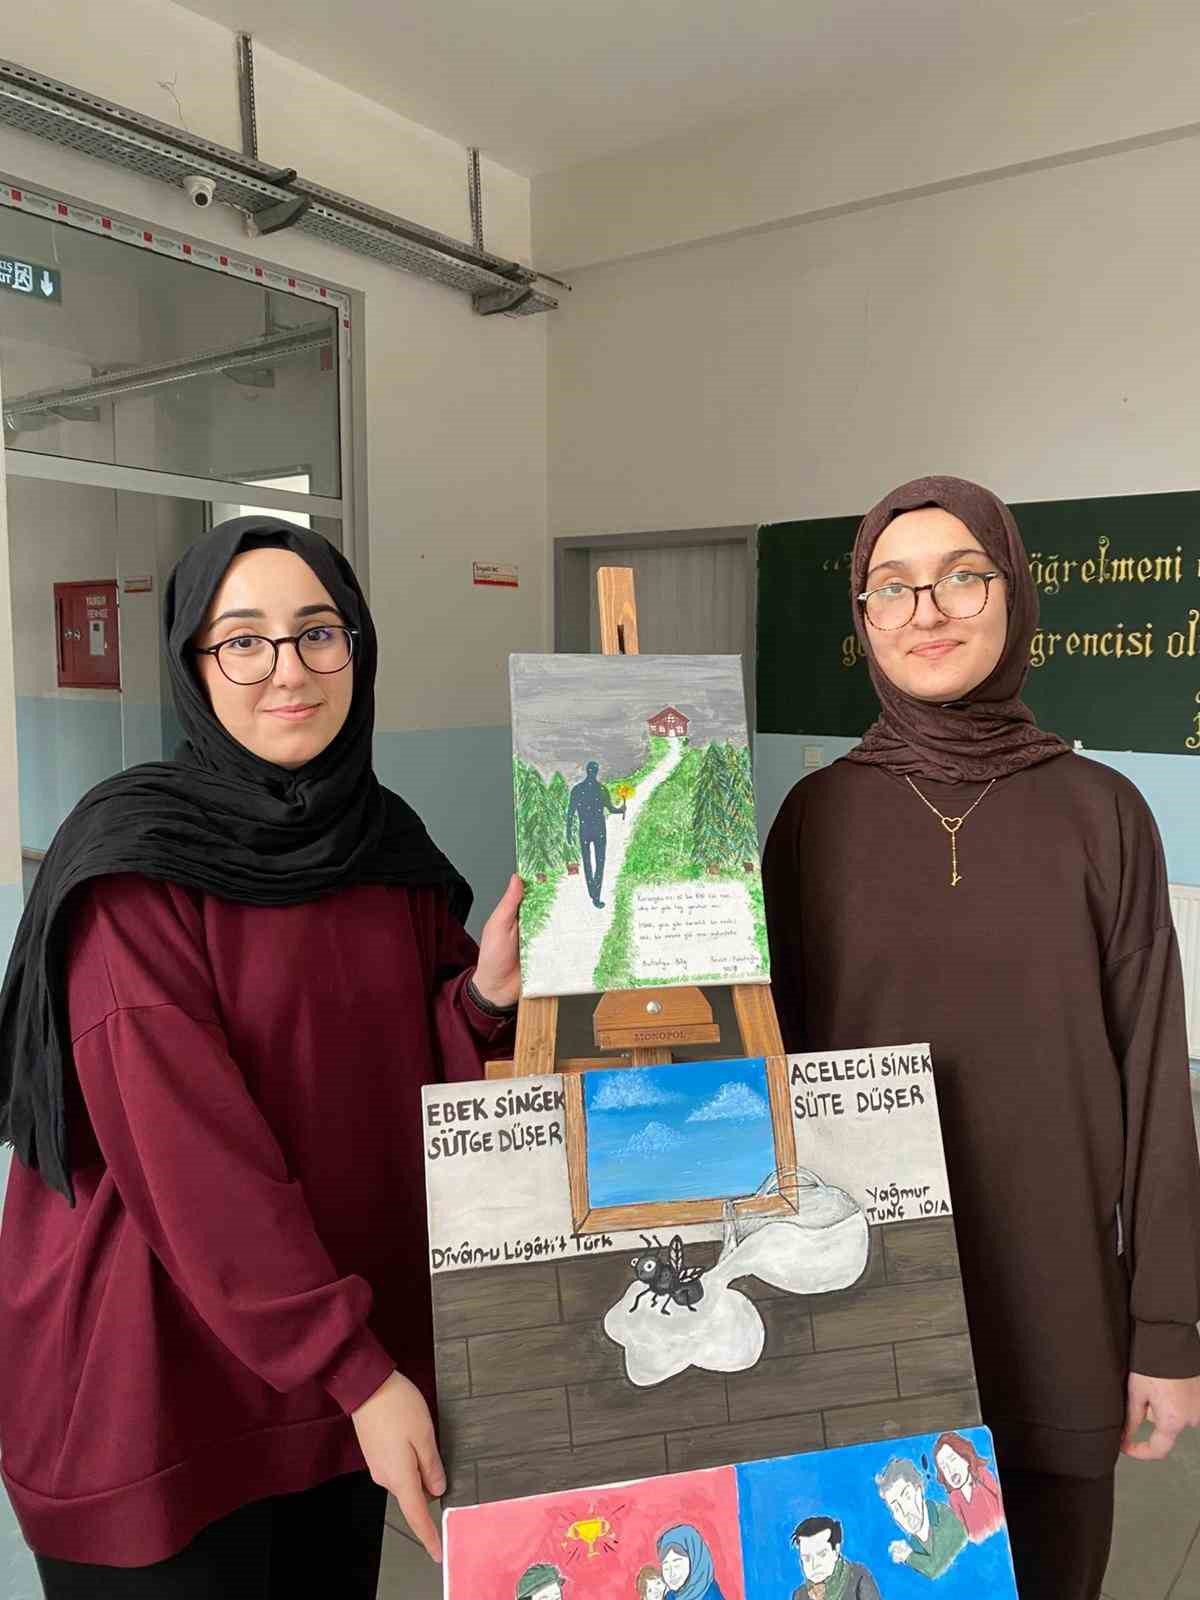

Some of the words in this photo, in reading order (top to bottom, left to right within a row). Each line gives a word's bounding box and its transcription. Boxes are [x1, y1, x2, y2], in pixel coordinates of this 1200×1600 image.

[1029, 623, 1153, 667] ğrencisi
[1166, 609, 1200, 658] ol
[634, 1030, 689, 1041] MONOPOL
[791, 1053, 875, 1085] ACELECİ
[880, 1052, 932, 1077] SİNEK
[426, 1097, 489, 1127] EBEK
[794, 1091, 844, 1119] SÜTE
[856, 1084, 925, 1114] DÜŞER
[428, 1127, 493, 1160] SÜTGE
[498, 1121, 563, 1152] DÜŞER
[865, 1182, 931, 1208] Yağmur
